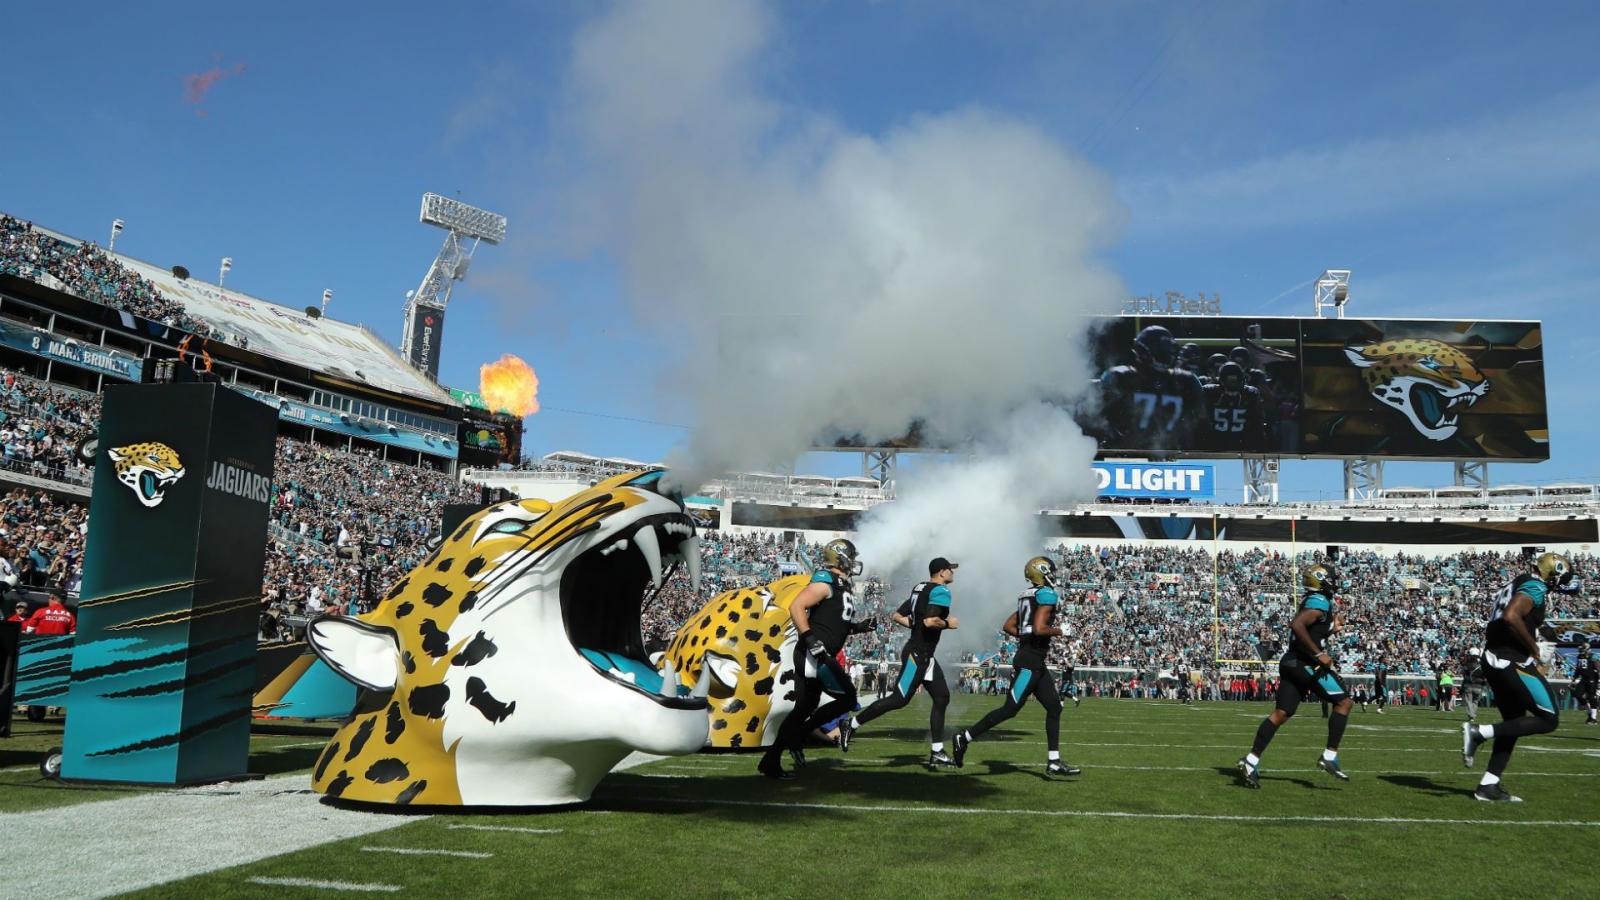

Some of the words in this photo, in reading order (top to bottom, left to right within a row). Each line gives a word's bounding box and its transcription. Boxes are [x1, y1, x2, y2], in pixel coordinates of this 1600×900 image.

[1165, 290, 1221, 312] Field
[31, 336, 41, 350] 8
[1133, 392, 1183, 432] 77
[1214, 408, 1246, 432] 55
[206, 461, 270, 503] JAGUARS
[1115, 467, 1205, 491] LIGHT
